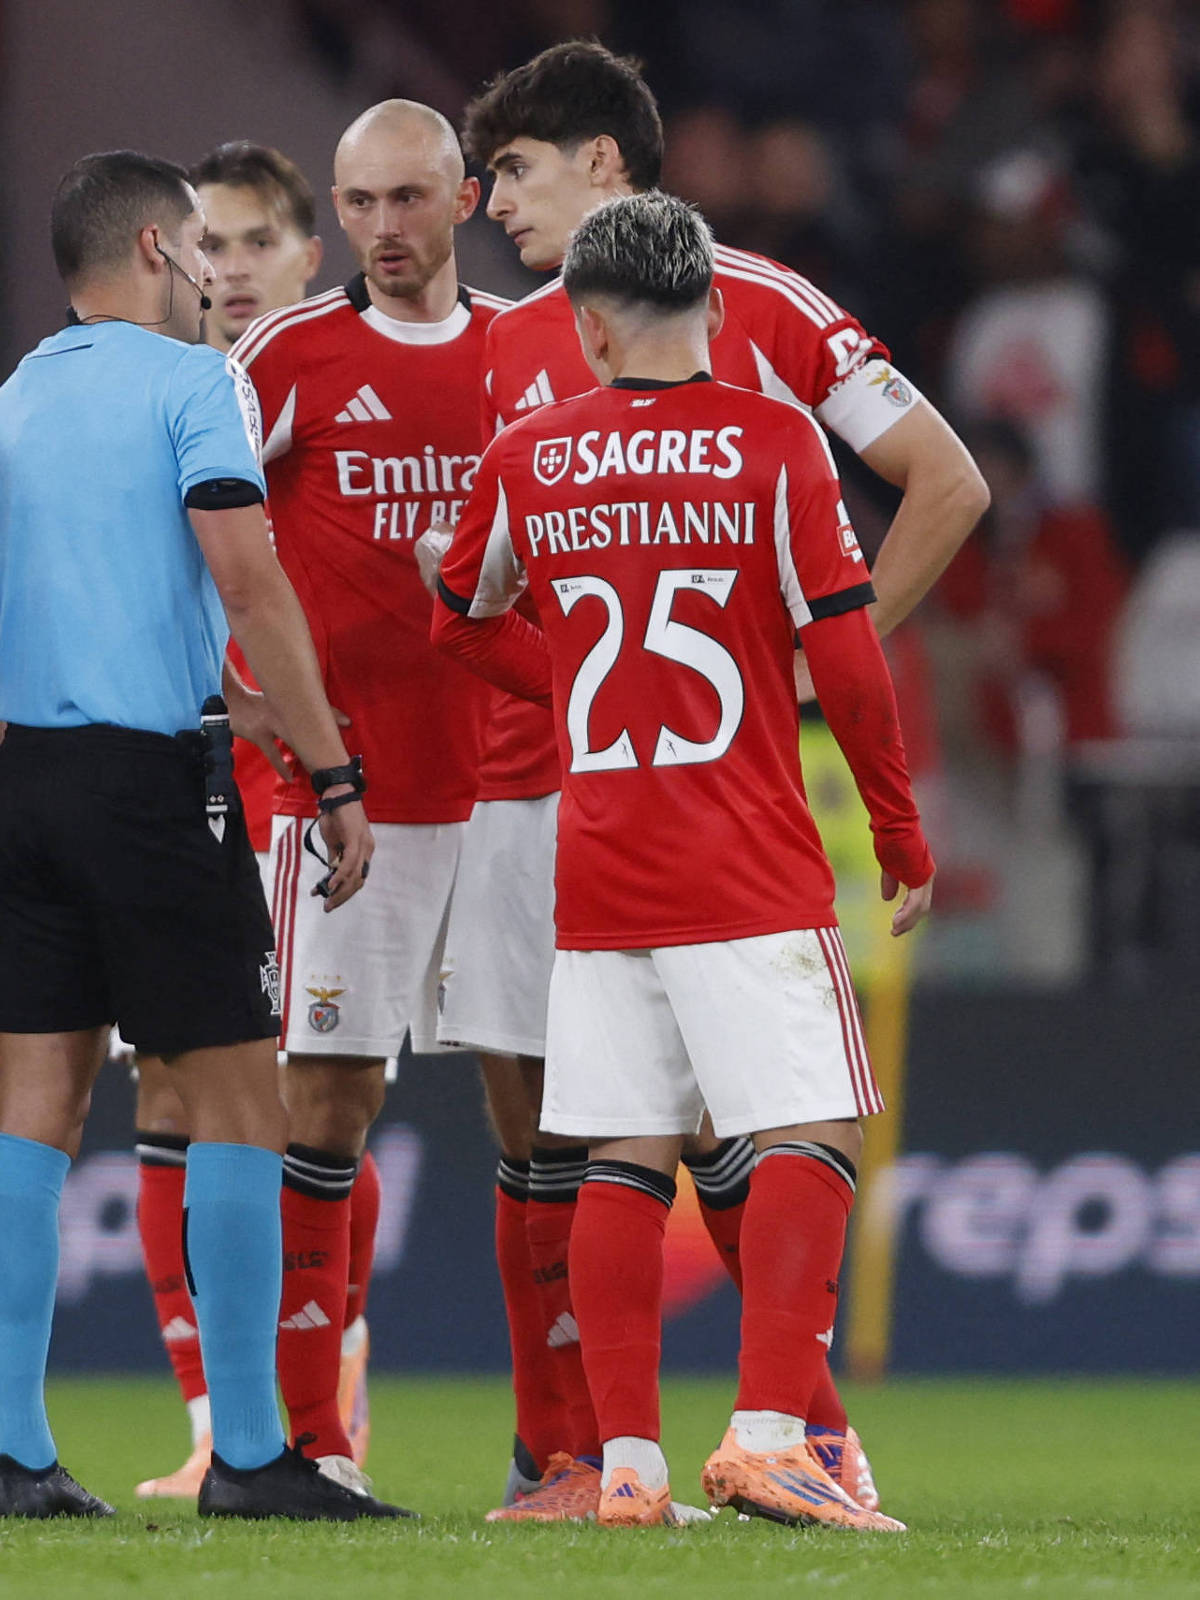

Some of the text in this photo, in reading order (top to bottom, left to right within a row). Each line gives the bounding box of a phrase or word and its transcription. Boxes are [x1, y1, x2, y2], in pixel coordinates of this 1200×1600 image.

[334, 444, 482, 496] Emira
[573, 426, 744, 485] SAGRES
[373, 501, 421, 540] FLY
[525, 501, 756, 558] PRESTIANNI
[550, 568, 745, 774] 25
[864, 1152, 1200, 1304] reps
